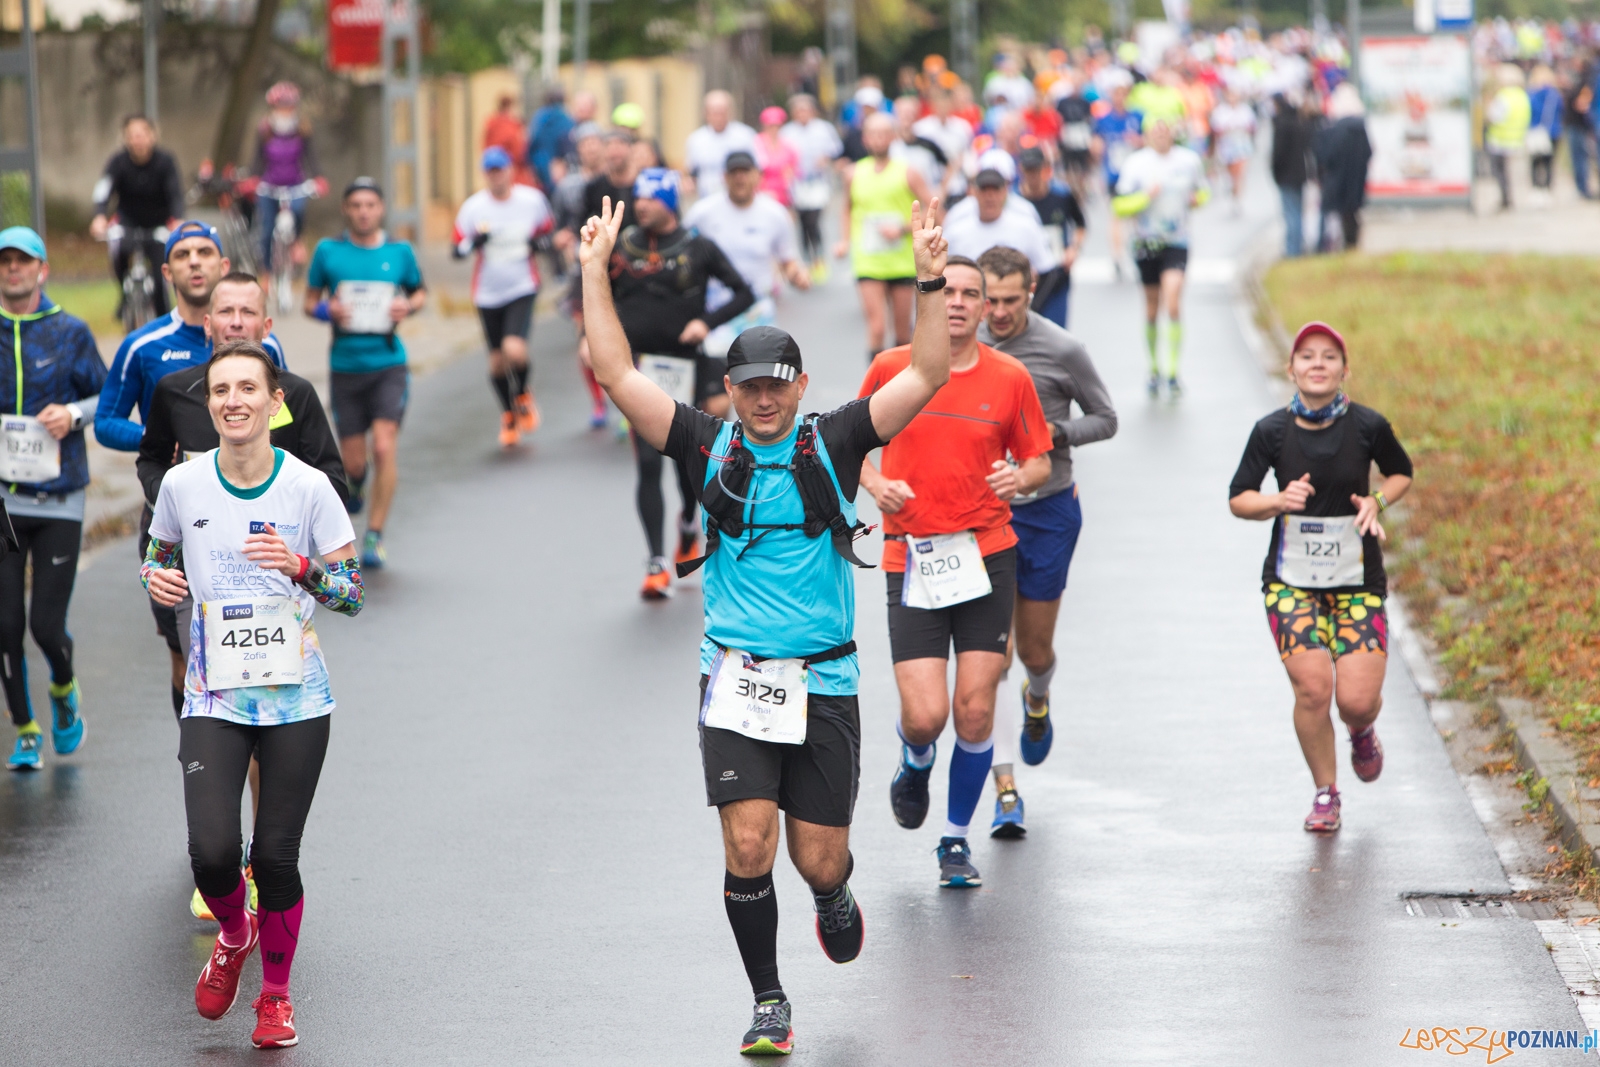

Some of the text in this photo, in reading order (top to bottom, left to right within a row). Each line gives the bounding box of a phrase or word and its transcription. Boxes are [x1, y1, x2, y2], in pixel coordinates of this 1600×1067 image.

[193, 519, 210, 529] 4F
[210, 550, 235, 561] SIŁA
[1305, 541, 1340, 556] 1221
[920, 555, 960, 576] 6120
[221, 627, 286, 648] 4264
[243, 651, 267, 661] Zofia
[735, 678, 787, 705] 3029
[730, 885, 771, 900] ROYAL BAY
